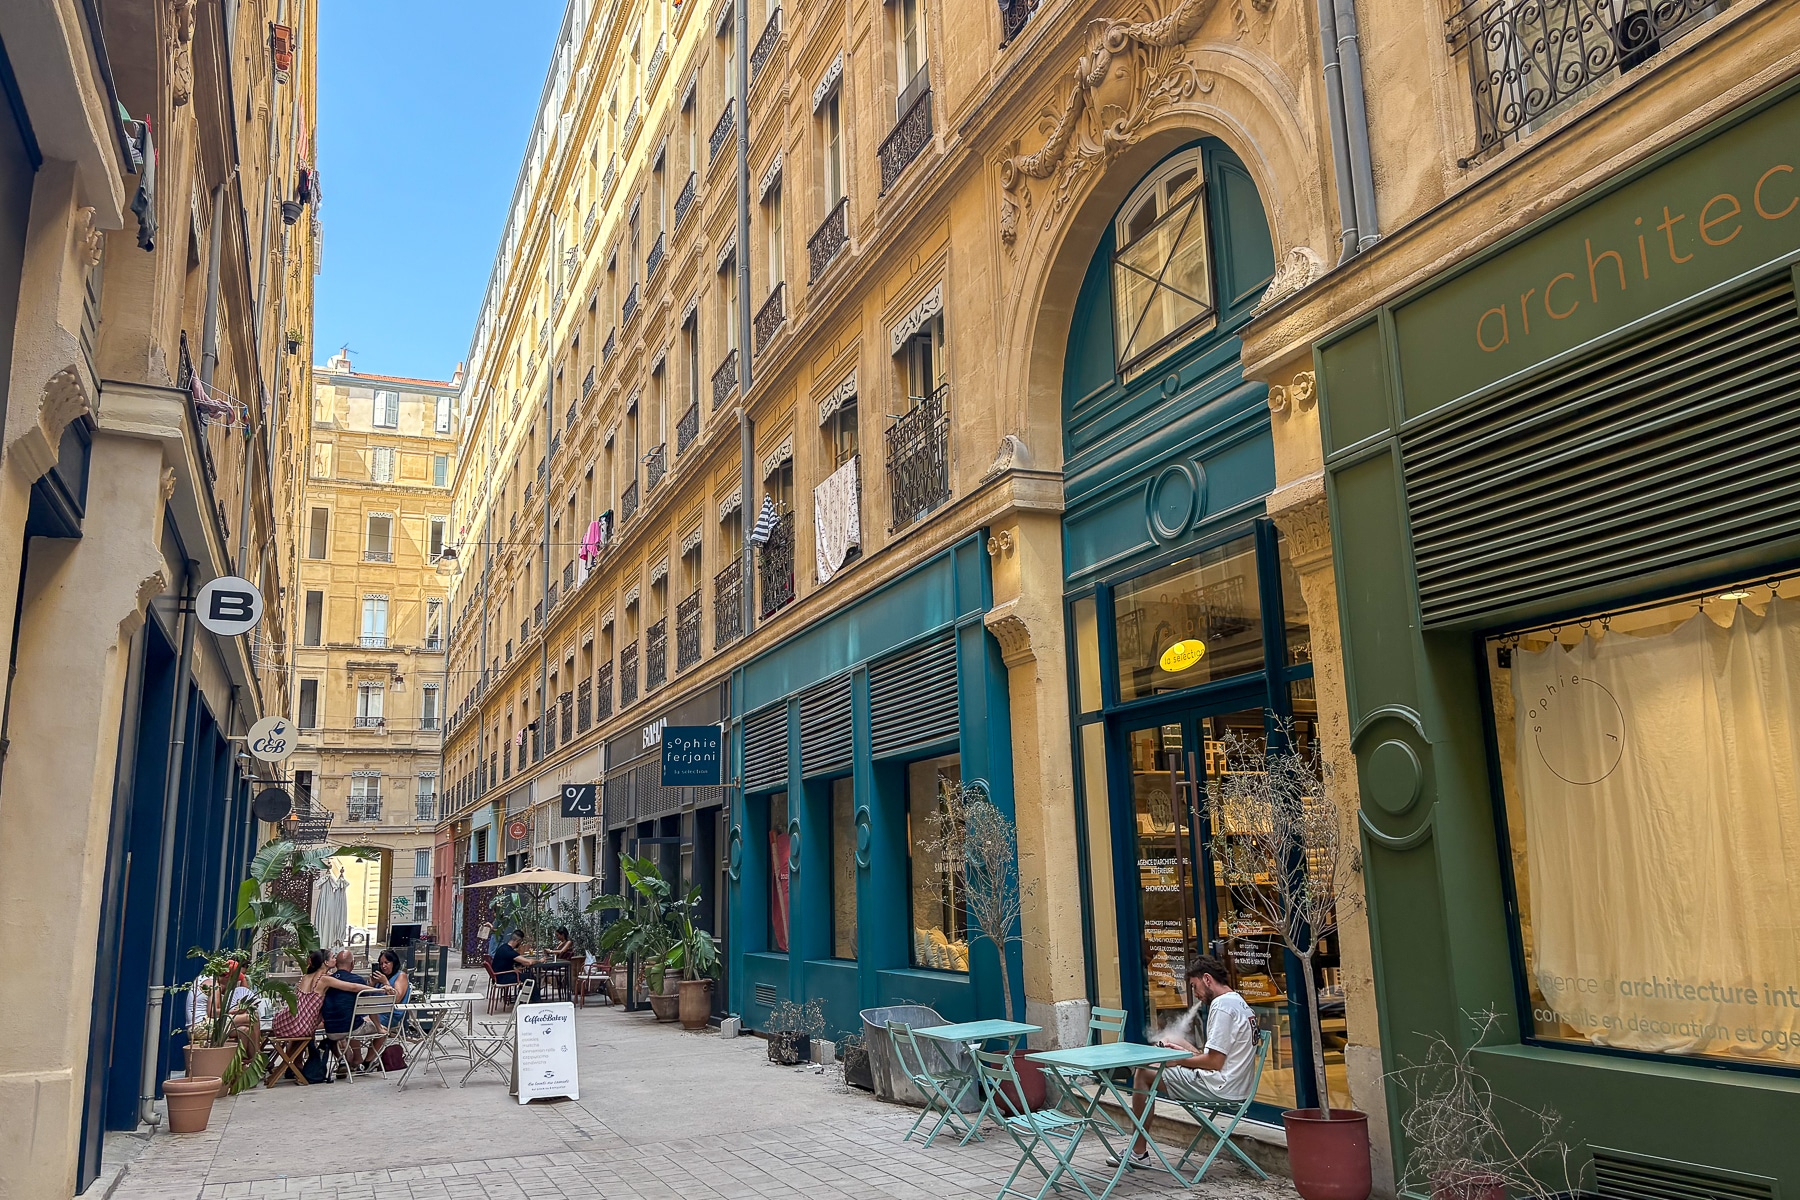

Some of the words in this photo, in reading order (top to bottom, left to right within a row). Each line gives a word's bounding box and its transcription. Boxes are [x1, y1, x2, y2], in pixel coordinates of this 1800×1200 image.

[1476, 164, 1800, 352] architec
[209, 589, 254, 622] B
[253, 738, 286, 754] C&B
[667, 737, 717, 752] sophie
[667, 751, 716, 764] ferjani
[1137, 858, 1153, 866] AGENCE
[1171, 884, 1180, 892] DÉC
[1602, 1015, 1623, 1030] en
[1628, 1013, 1730, 1042] décoration
[1735, 1024, 1756, 1043] et
